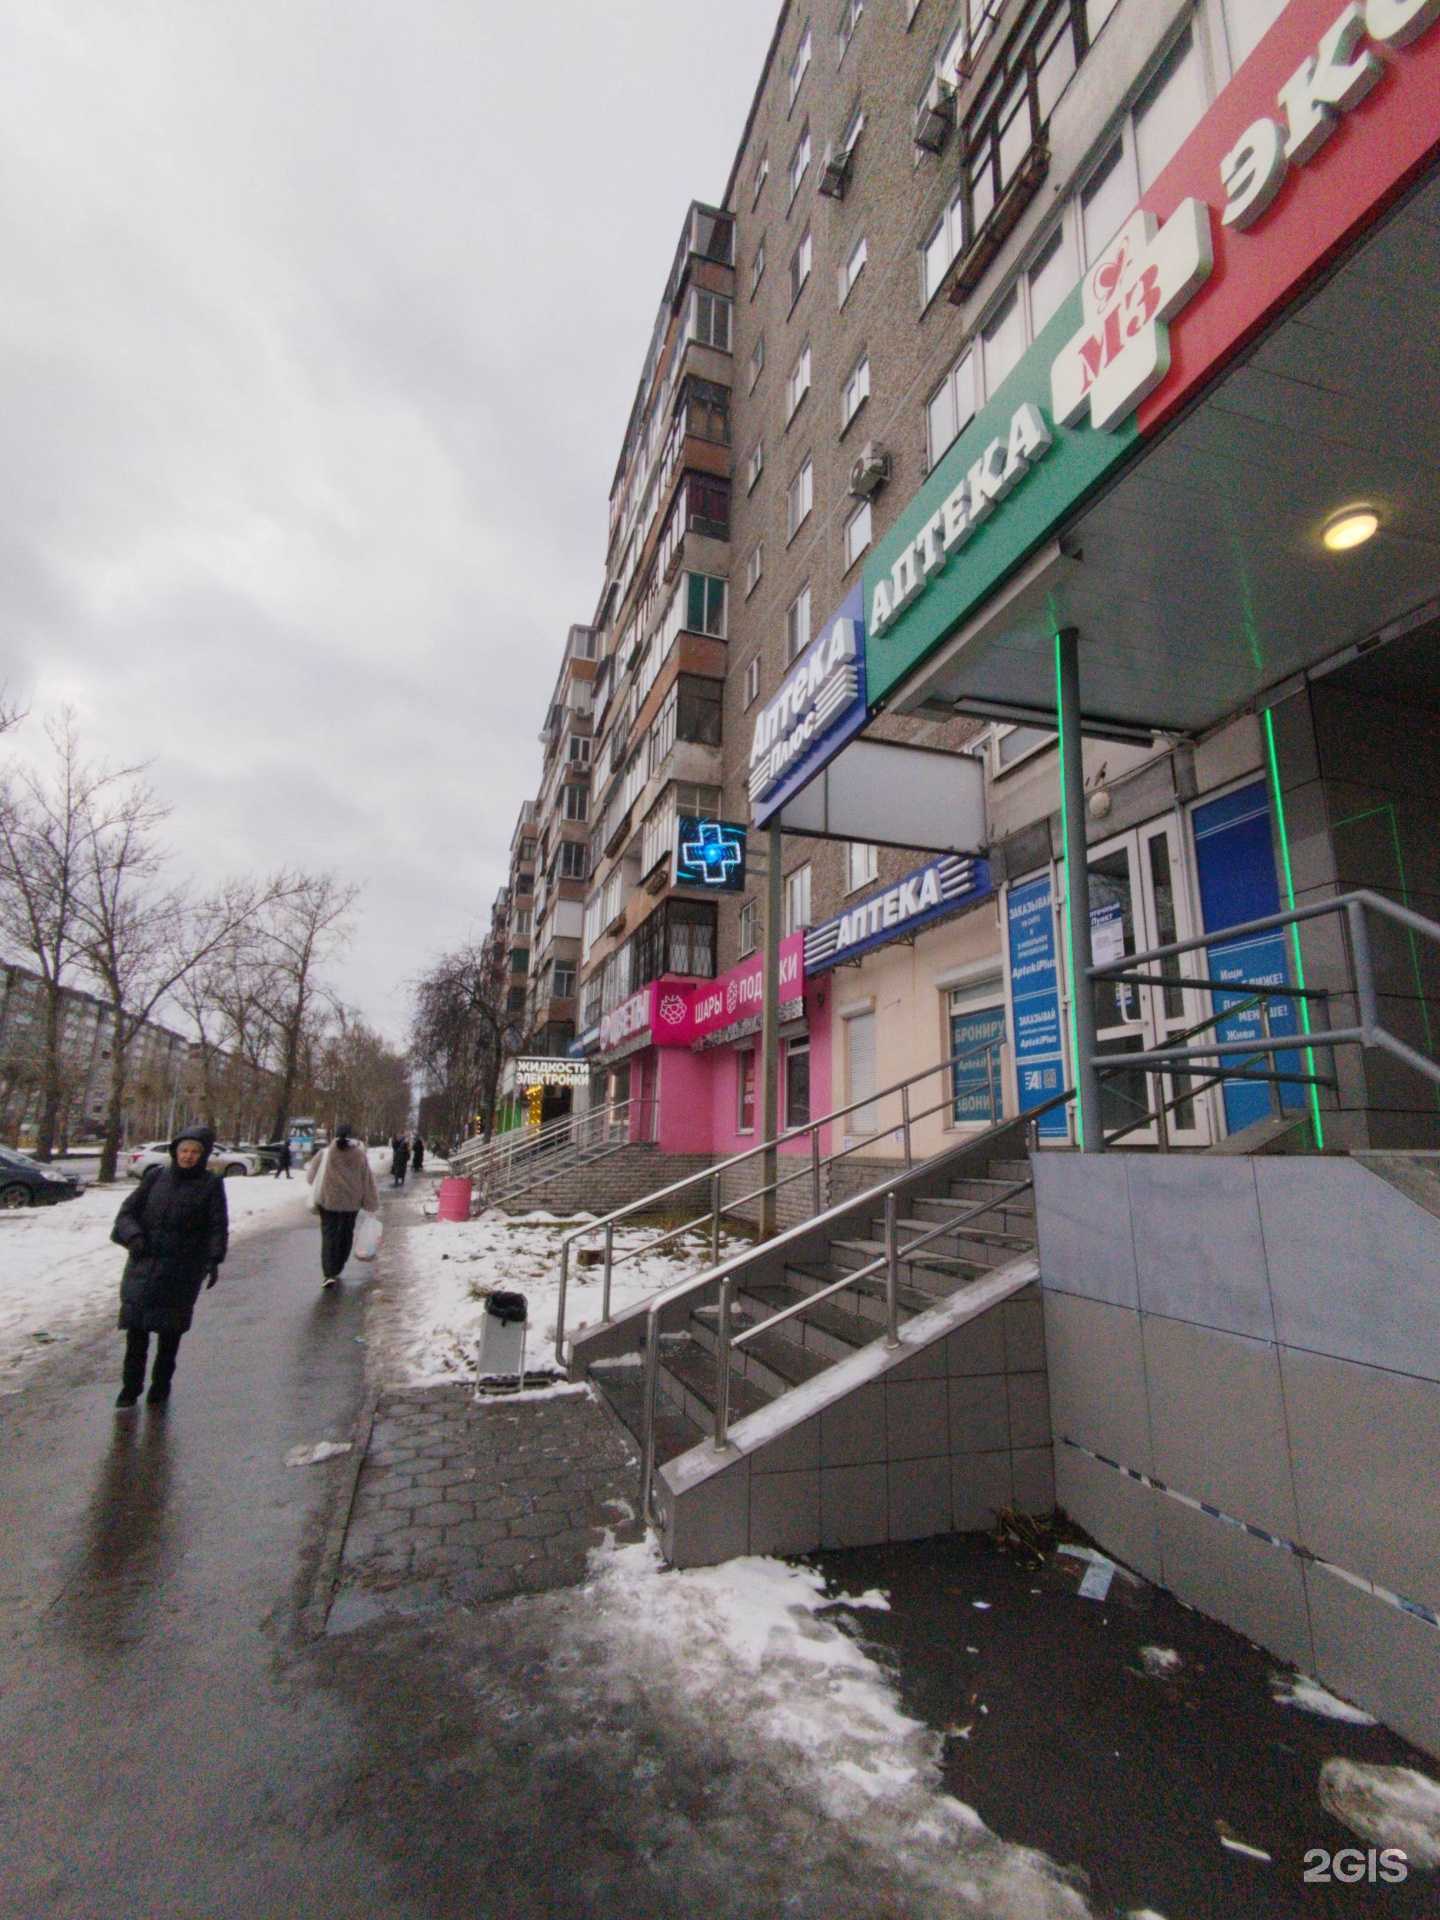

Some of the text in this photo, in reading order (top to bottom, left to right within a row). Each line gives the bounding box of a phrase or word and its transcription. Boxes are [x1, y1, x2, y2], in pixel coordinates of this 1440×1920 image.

[869, 402, 1053, 638] АПТЕКА
[835, 867, 944, 950] АПТЕКА
[695, 952, 798, 1025] ШАРЫ ПОДКИ
[1238, 1004, 1289, 1023] МЕНШЕ!
[955, 1020, 1005, 1044] БРОНИРУ
[516, 1072, 589, 1086] ЭЛЕКТРОНКИ
[517, 1061, 589, 1074] ЖИДКОСТИ
